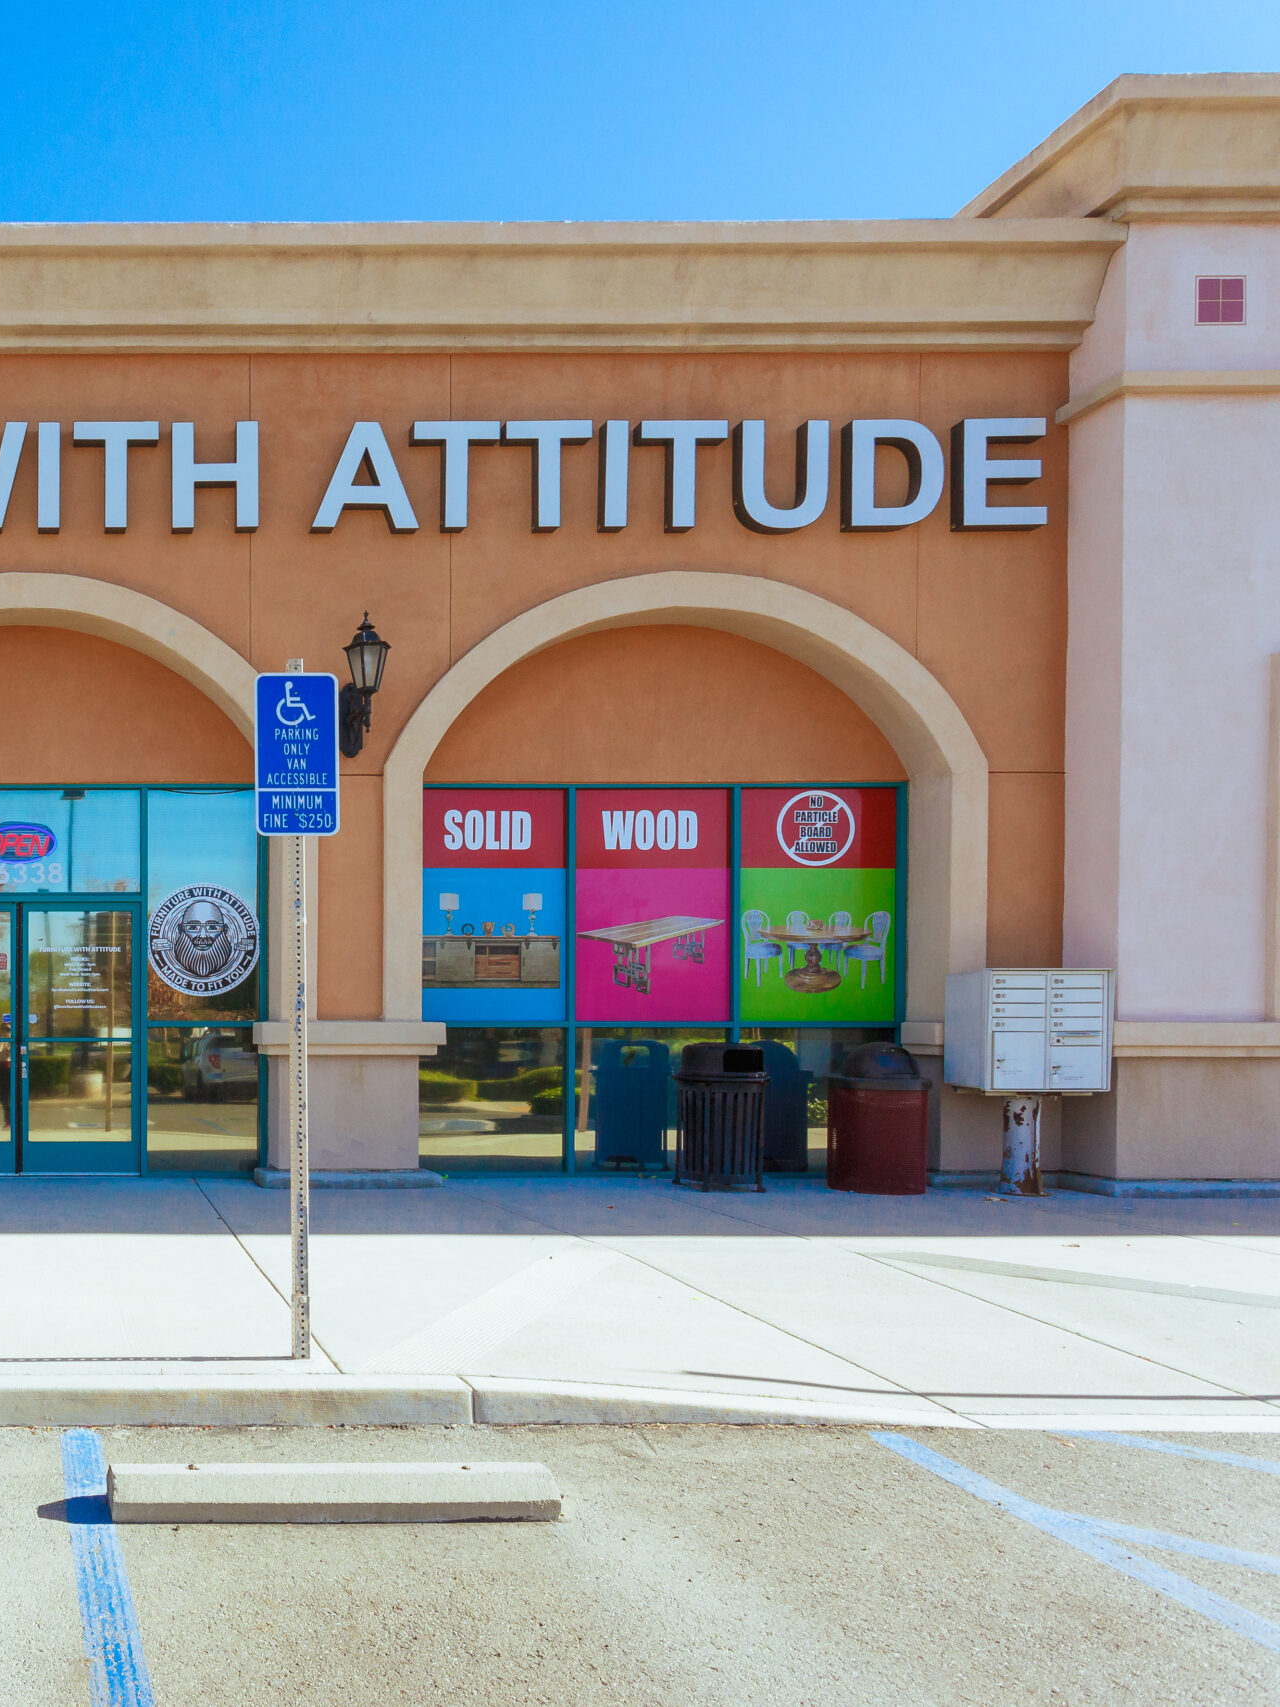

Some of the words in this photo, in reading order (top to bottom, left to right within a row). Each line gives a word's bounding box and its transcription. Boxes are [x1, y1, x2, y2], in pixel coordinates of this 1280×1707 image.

[311, 417, 1049, 533] ATTITUDE
[274, 728, 319, 741] PARKING
[283, 743, 310, 756] ONLY
[286, 758, 307, 770] VAN
[266, 772, 328, 785] ACCESSIBLE
[272, 794, 323, 810] MINIMUM
[809, 795, 824, 808] NO
[263, 813, 289, 828] FINE
[298, 812, 332, 829] $250
[794, 810, 839, 823] PARTICLE
[443, 809, 532, 851] SOLID
[601, 809, 699, 851] WOOD
[799, 826, 832, 838] BOARD
[793, 841, 838, 853] ALLOWED
[151, 890, 192, 937] FURNITURE
[192, 887, 222, 898] WITH
[222, 893, 256, 936] ATTITUDE
[161, 965, 189, 988] MADE
[190, 981, 205, 991] TO
[208, 980, 224, 991] FIT
[225, 964, 245, 984] YOU
